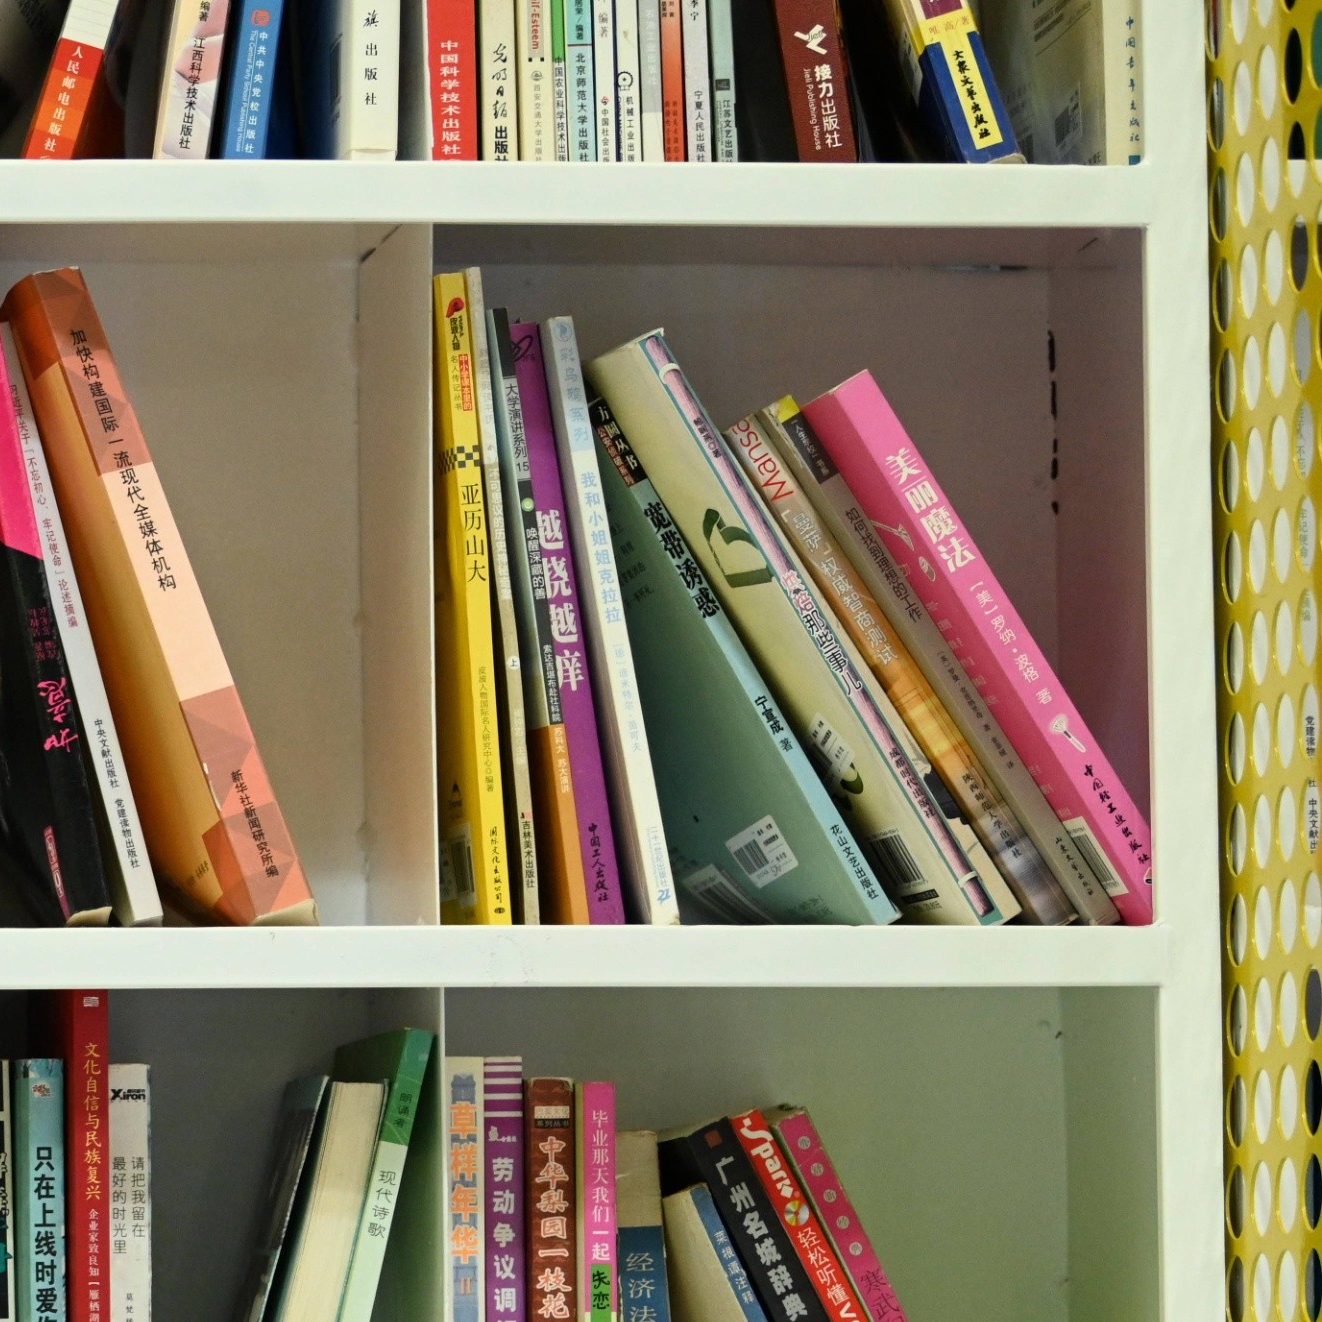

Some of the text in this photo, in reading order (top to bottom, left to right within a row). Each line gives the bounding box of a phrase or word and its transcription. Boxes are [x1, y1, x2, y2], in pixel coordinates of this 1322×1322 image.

[42, 46, 84, 151] 人民邮电出版社
[179, 39, 206, 150] 江西科学技术出版社
[439, 39, 461, 157] 中国科学技术出版社
[814, 64, 842, 148] 接力出版社
[69, 329, 177, 592] 加快构建国际一流现代全媒体机构
[885, 446, 977, 573] 美丽魔法
[460, 483, 487, 583] 亚历山大
[580, 471, 622, 624] 我和小姐姐克拉拉
[536, 509, 585, 692] 越挠越痒
[829, 825, 879, 900] 花山文艺出版社
[84, 1042, 102, 1201] 文化自信与民族复兴
[113, 1157, 128, 1255] 最好的时光里
[132, 1157, 146, 1238] 请把我留在
[366, 1169, 397, 1240] 现代诗歌
[592, 1109, 610, 1261] 毕业那天我们一起
[714, 1155, 808, 1322] 广州名城辞典
